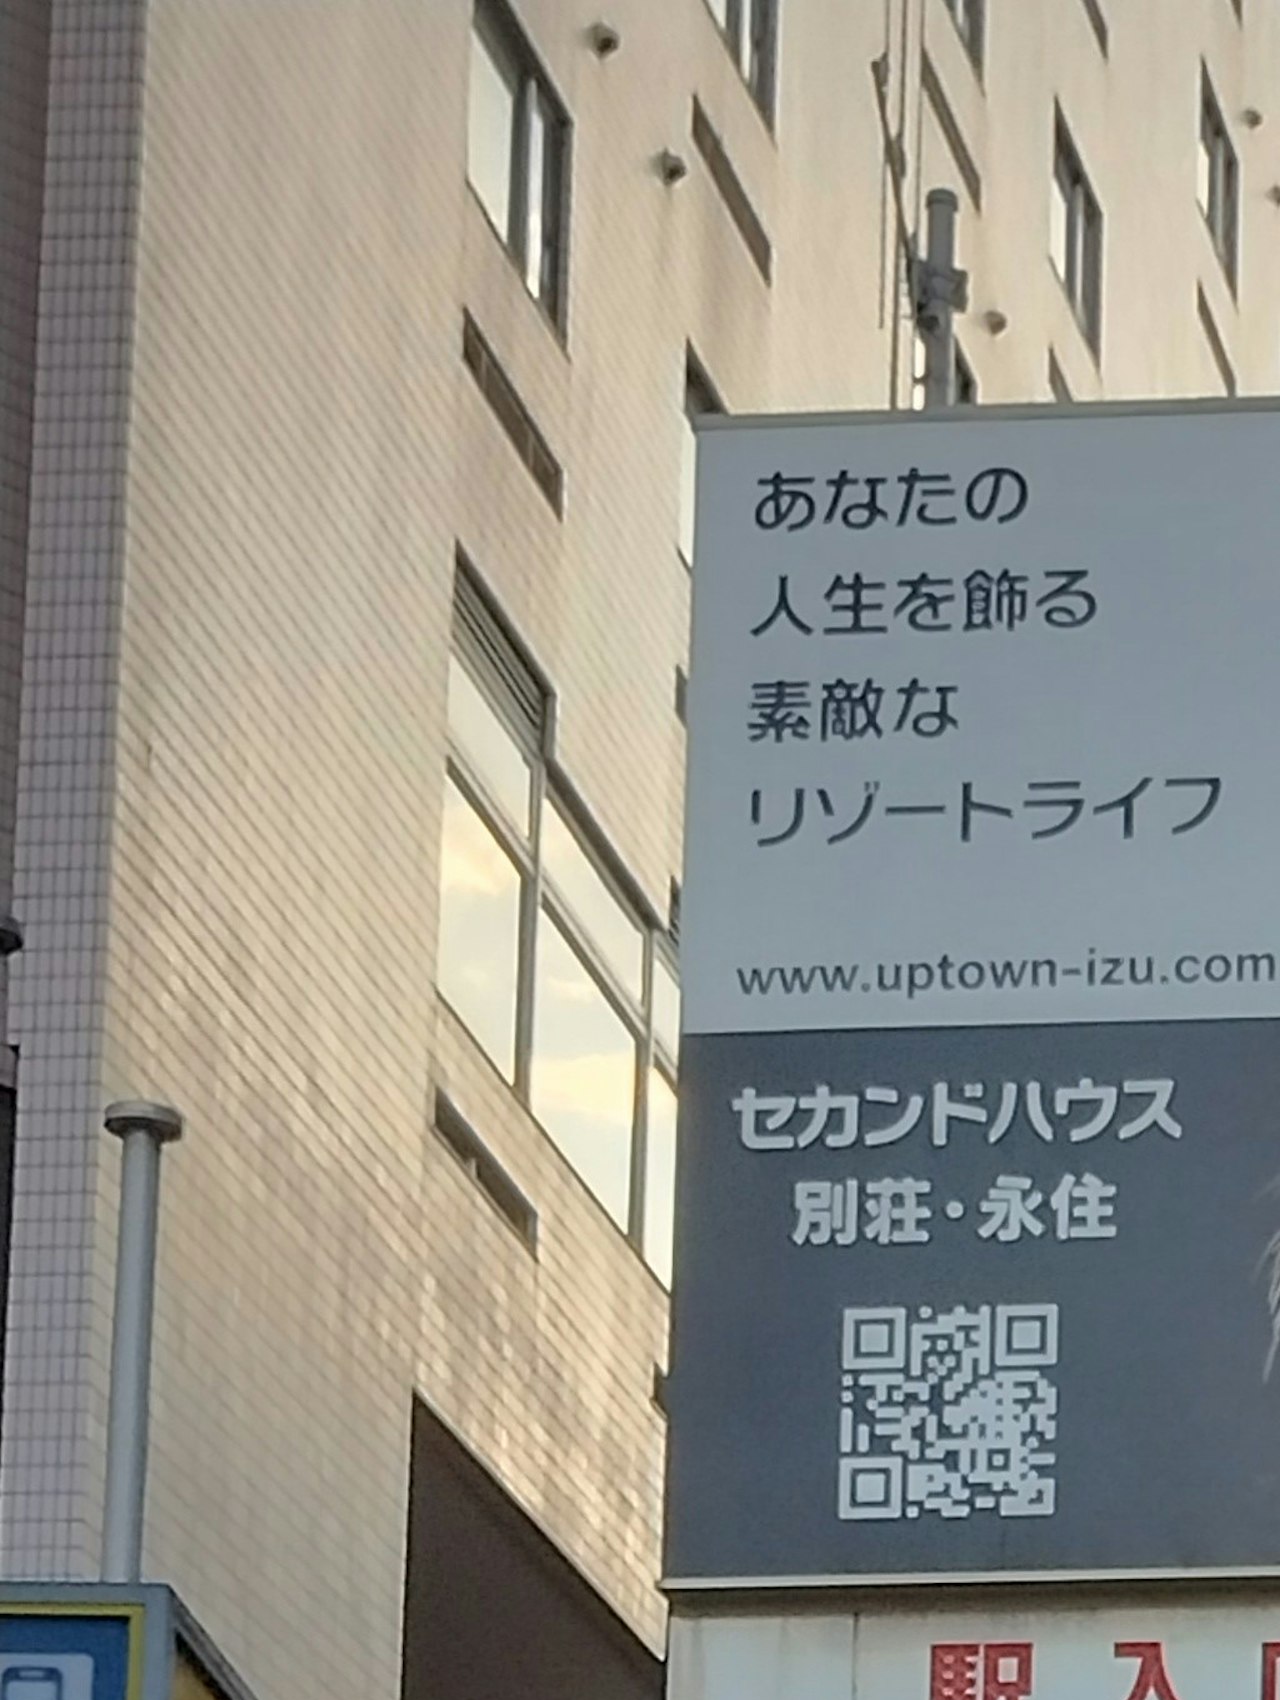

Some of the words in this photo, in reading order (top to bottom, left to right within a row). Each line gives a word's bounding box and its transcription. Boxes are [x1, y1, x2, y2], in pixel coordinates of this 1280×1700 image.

[755, 467, 1029, 532] あなたの
[749, 568, 1098, 637] 人生を飾る
[747, 677, 960, 743] 素敵な
[749, 776, 1222, 847] リゾートライフ
[737, 946, 1276, 999] www.uptown-izu.com
[732, 1078, 1182, 1149] セカンドハウス
[792, 1174, 1117, 1246] 別荘・永住
